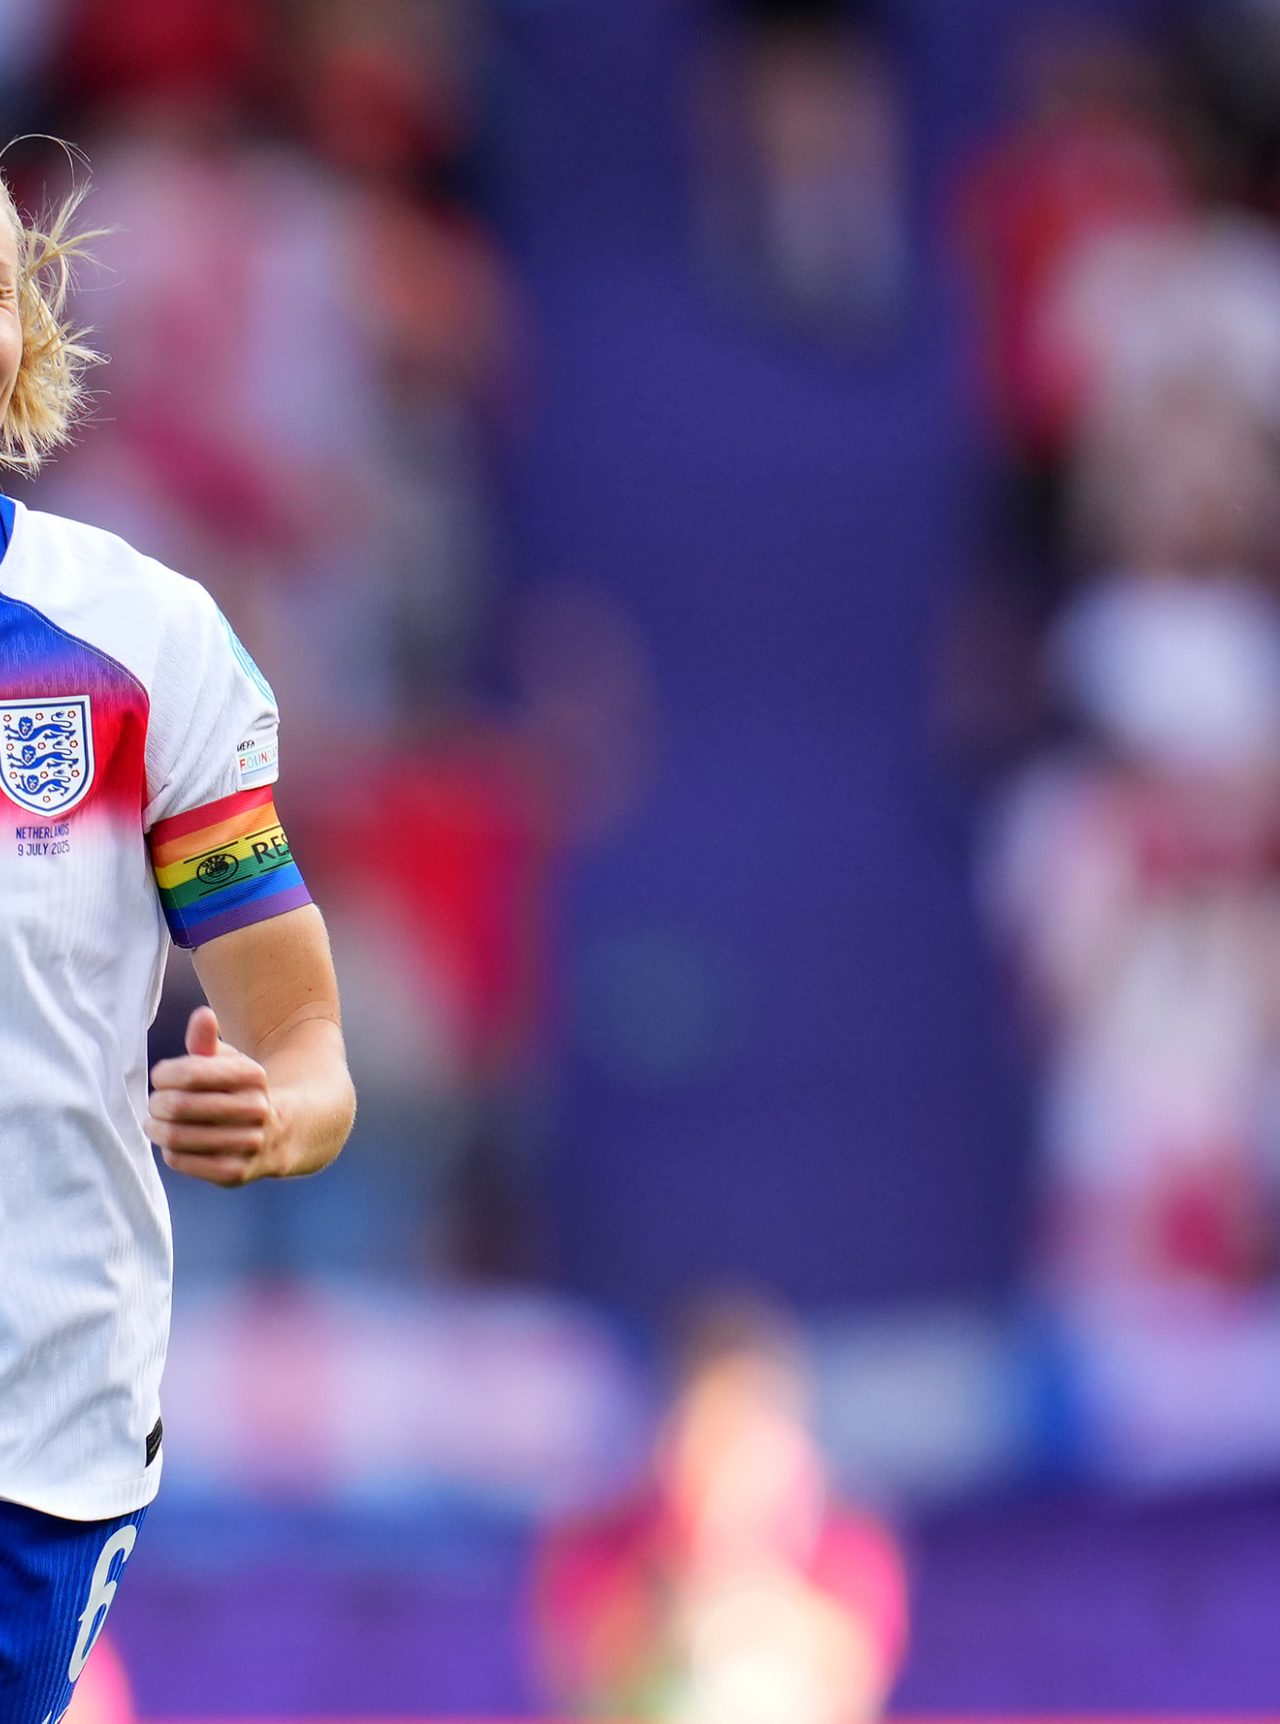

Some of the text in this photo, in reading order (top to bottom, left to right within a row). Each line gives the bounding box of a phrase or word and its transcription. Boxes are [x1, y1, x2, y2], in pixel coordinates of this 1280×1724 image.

[15, 823, 70, 839] NETHERLANDS
[17, 840, 70, 857] 9 JULY 2025
[68, 1524, 137, 1683] 6
